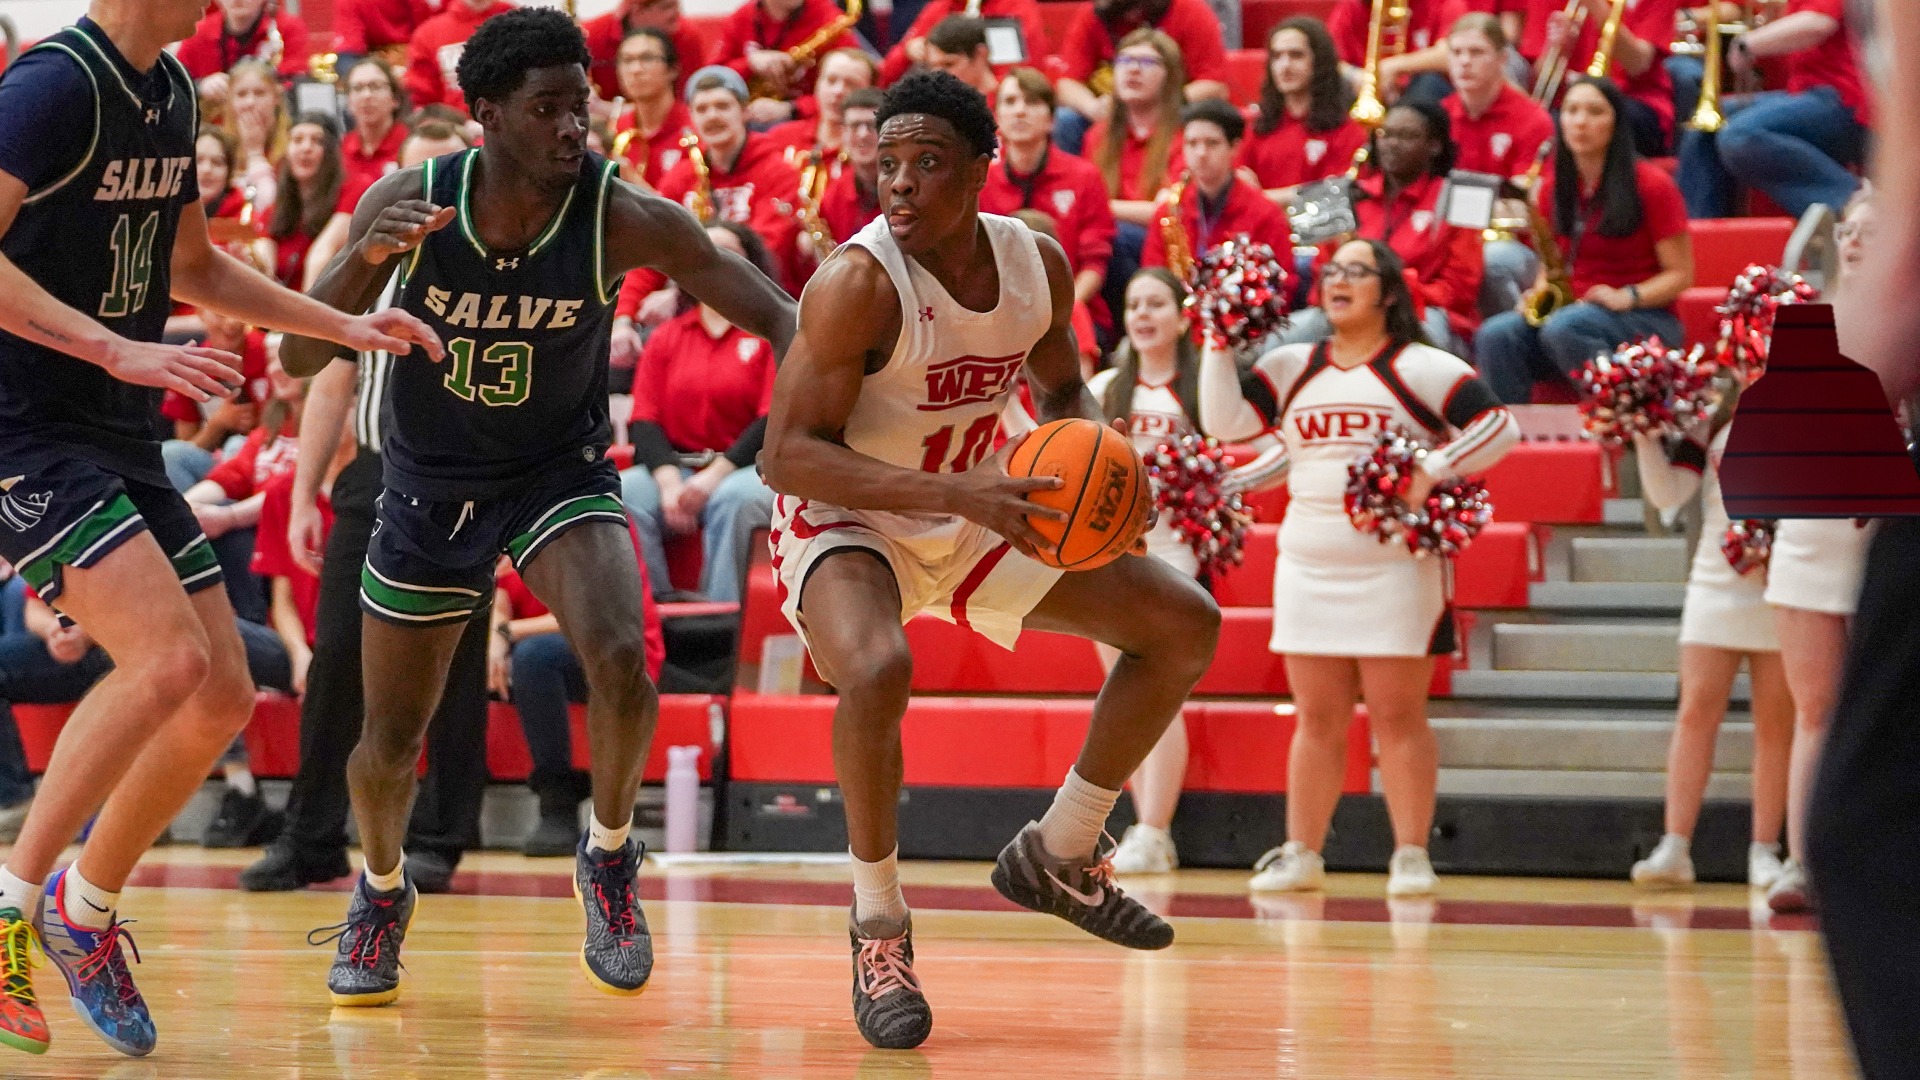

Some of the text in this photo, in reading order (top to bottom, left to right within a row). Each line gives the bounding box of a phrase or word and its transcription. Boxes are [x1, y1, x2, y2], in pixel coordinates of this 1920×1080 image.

[93, 156, 192, 201] SALVE
[98, 210, 160, 317] 14
[424, 284, 585, 330] SALVE
[443, 336, 535, 407] 13
[925, 358, 1025, 403] WPI
[920, 411, 999, 474] 10
[1294, 411, 1394, 440] WPI
[1088, 457, 1130, 533] NCAA
